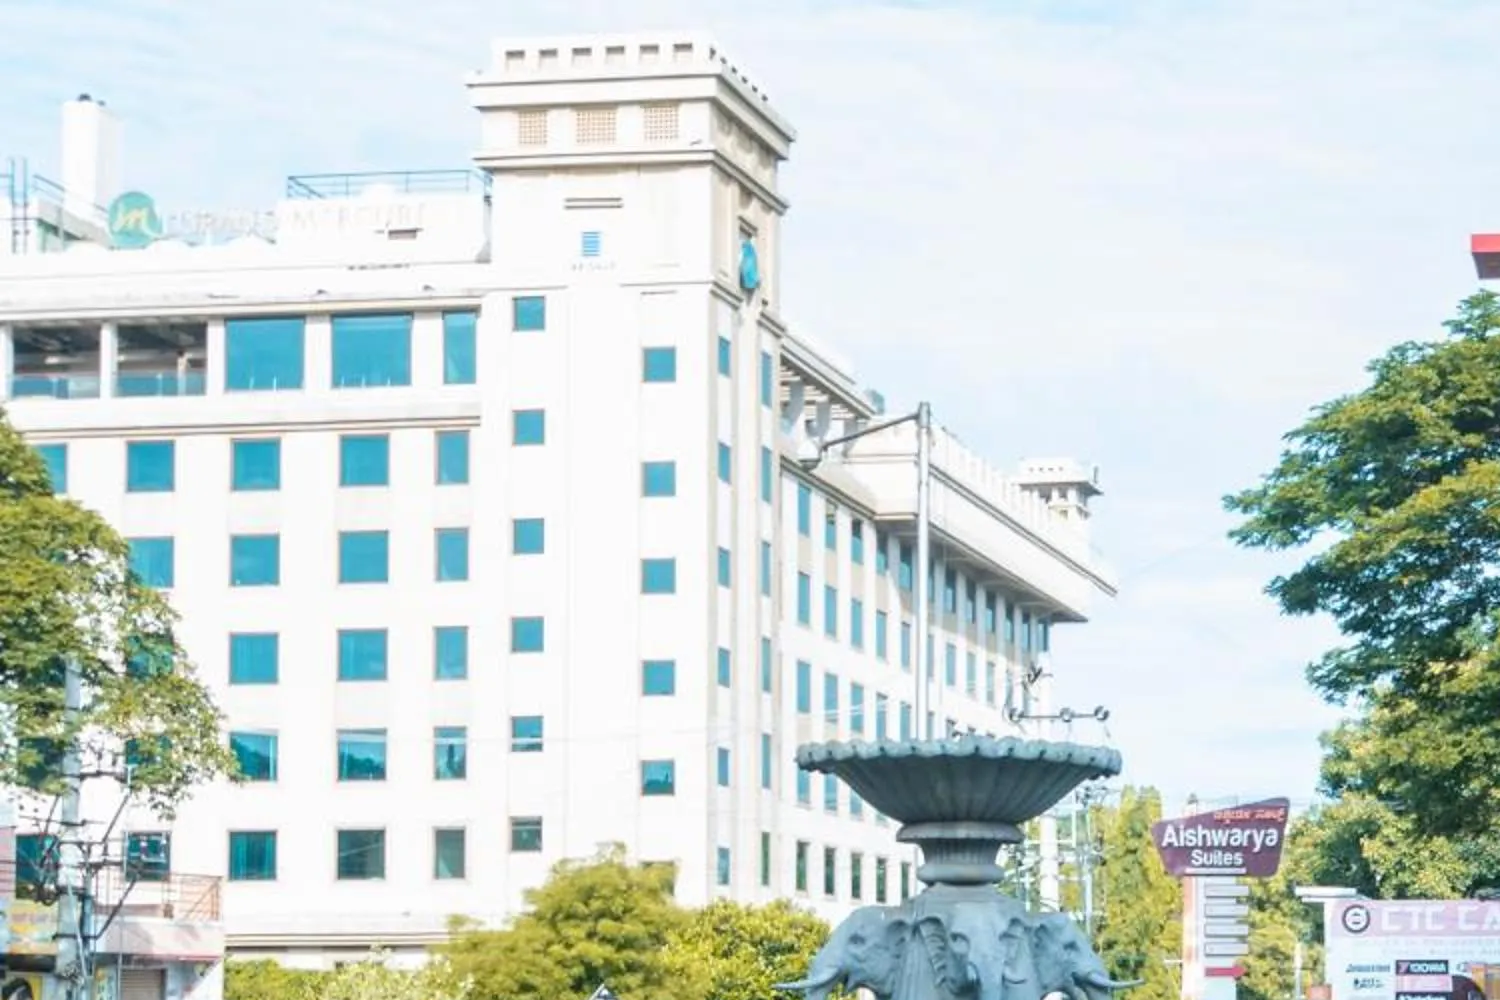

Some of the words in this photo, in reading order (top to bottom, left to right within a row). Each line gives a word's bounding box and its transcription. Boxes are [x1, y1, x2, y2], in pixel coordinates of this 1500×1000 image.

[1160, 823, 1279, 853] Aishwarya
[1190, 848, 1245, 866] Suites
[1381, 905, 1447, 931] CTC
